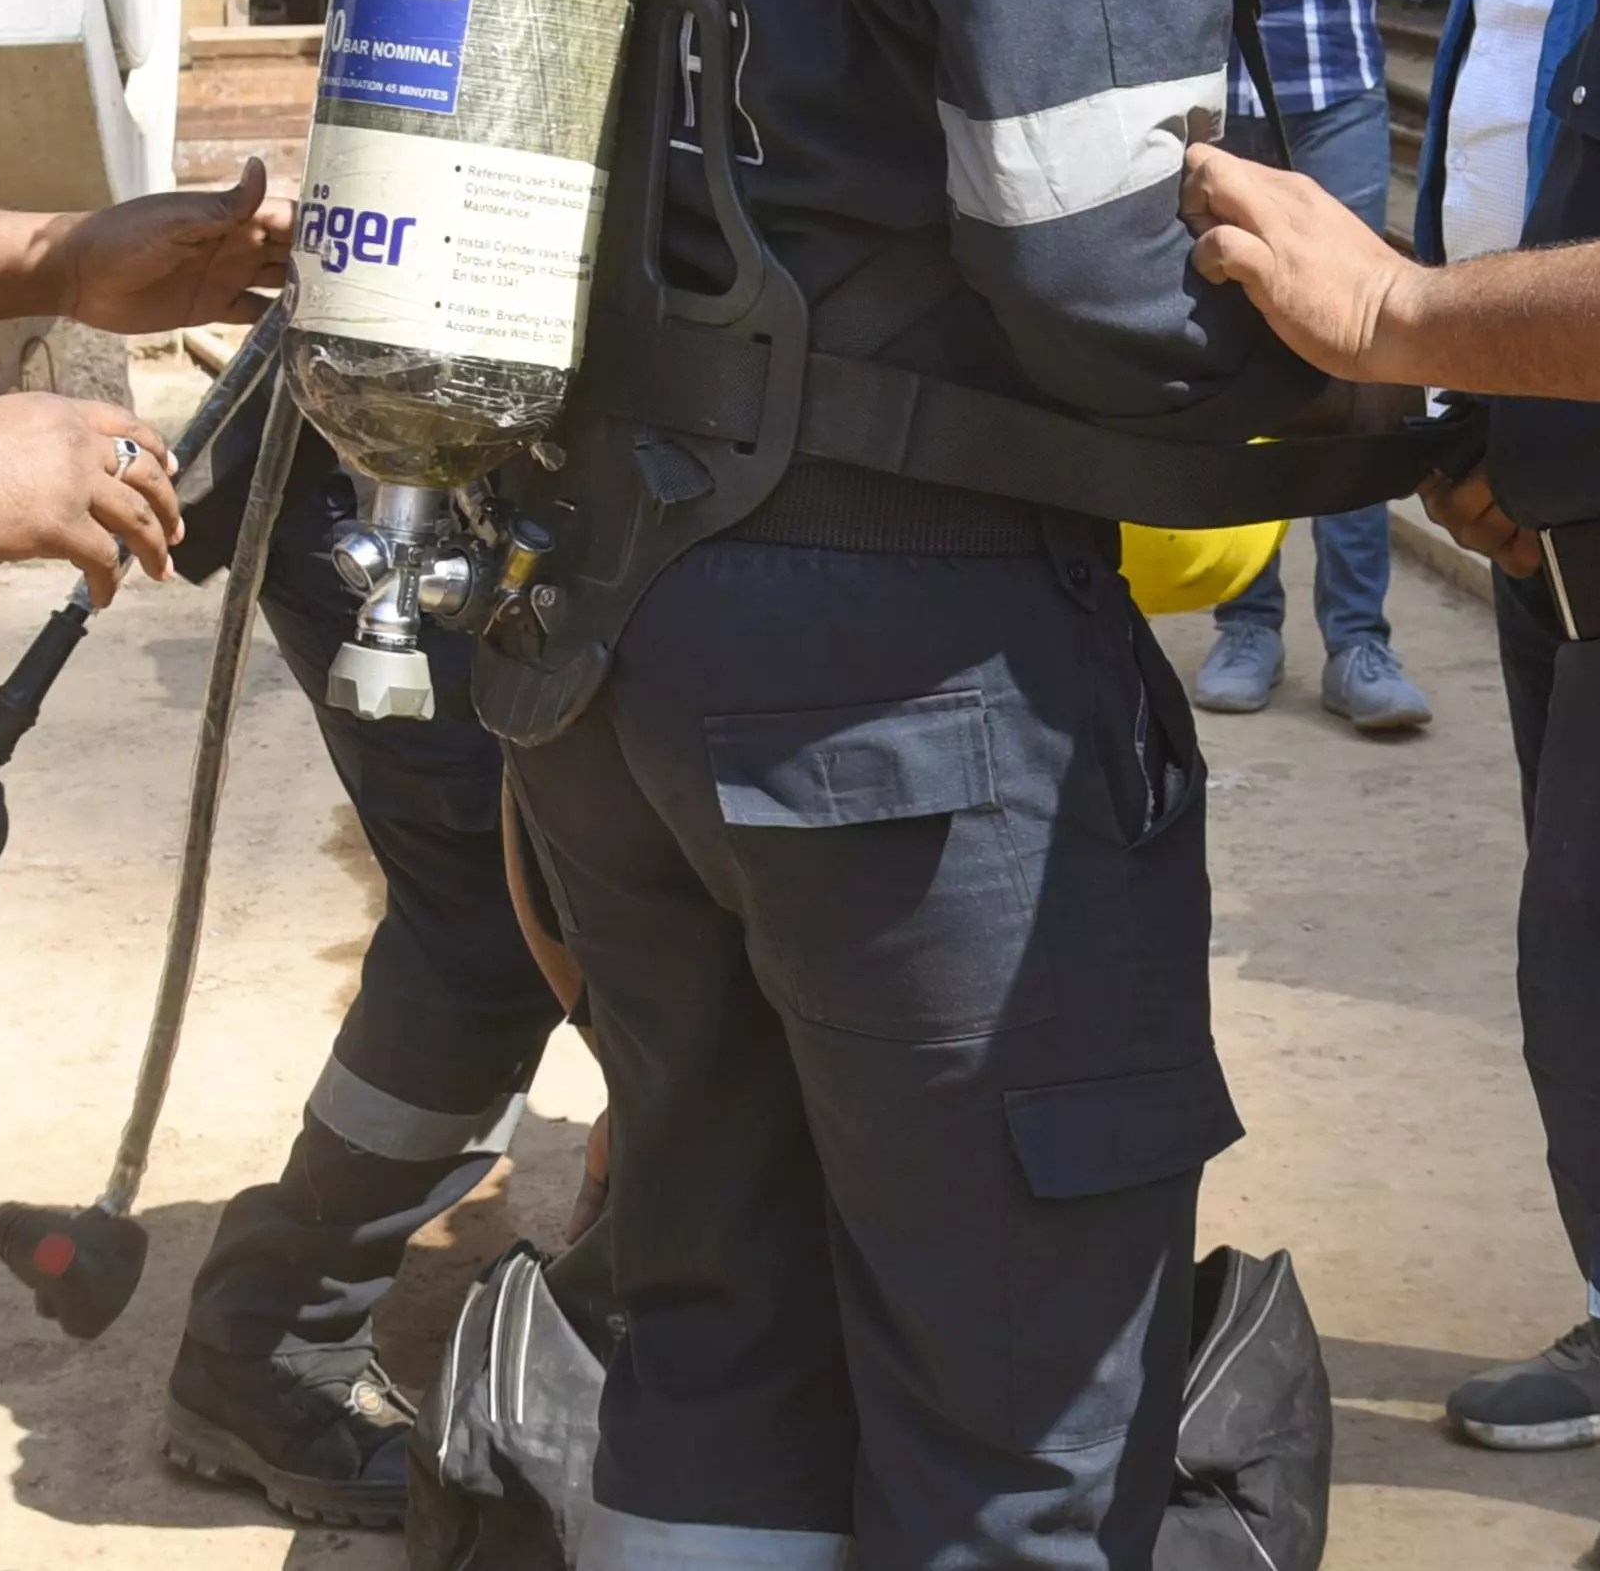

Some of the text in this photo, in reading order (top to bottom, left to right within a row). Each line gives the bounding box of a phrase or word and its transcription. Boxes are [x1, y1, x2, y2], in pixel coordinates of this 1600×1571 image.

[342, 37, 370, 56] BAR
[372, 40, 454, 68] NOMINAL
[384, 82, 398, 95] 45
[398, 84, 449, 102] MINUTES
[467, 164, 522, 185] Reference
[464, 181, 512, 199] Cylinder
[463, 199, 531, 219] Maintenance
[456, 235, 491, 251] Install
[456, 252, 493, 269] Torque
